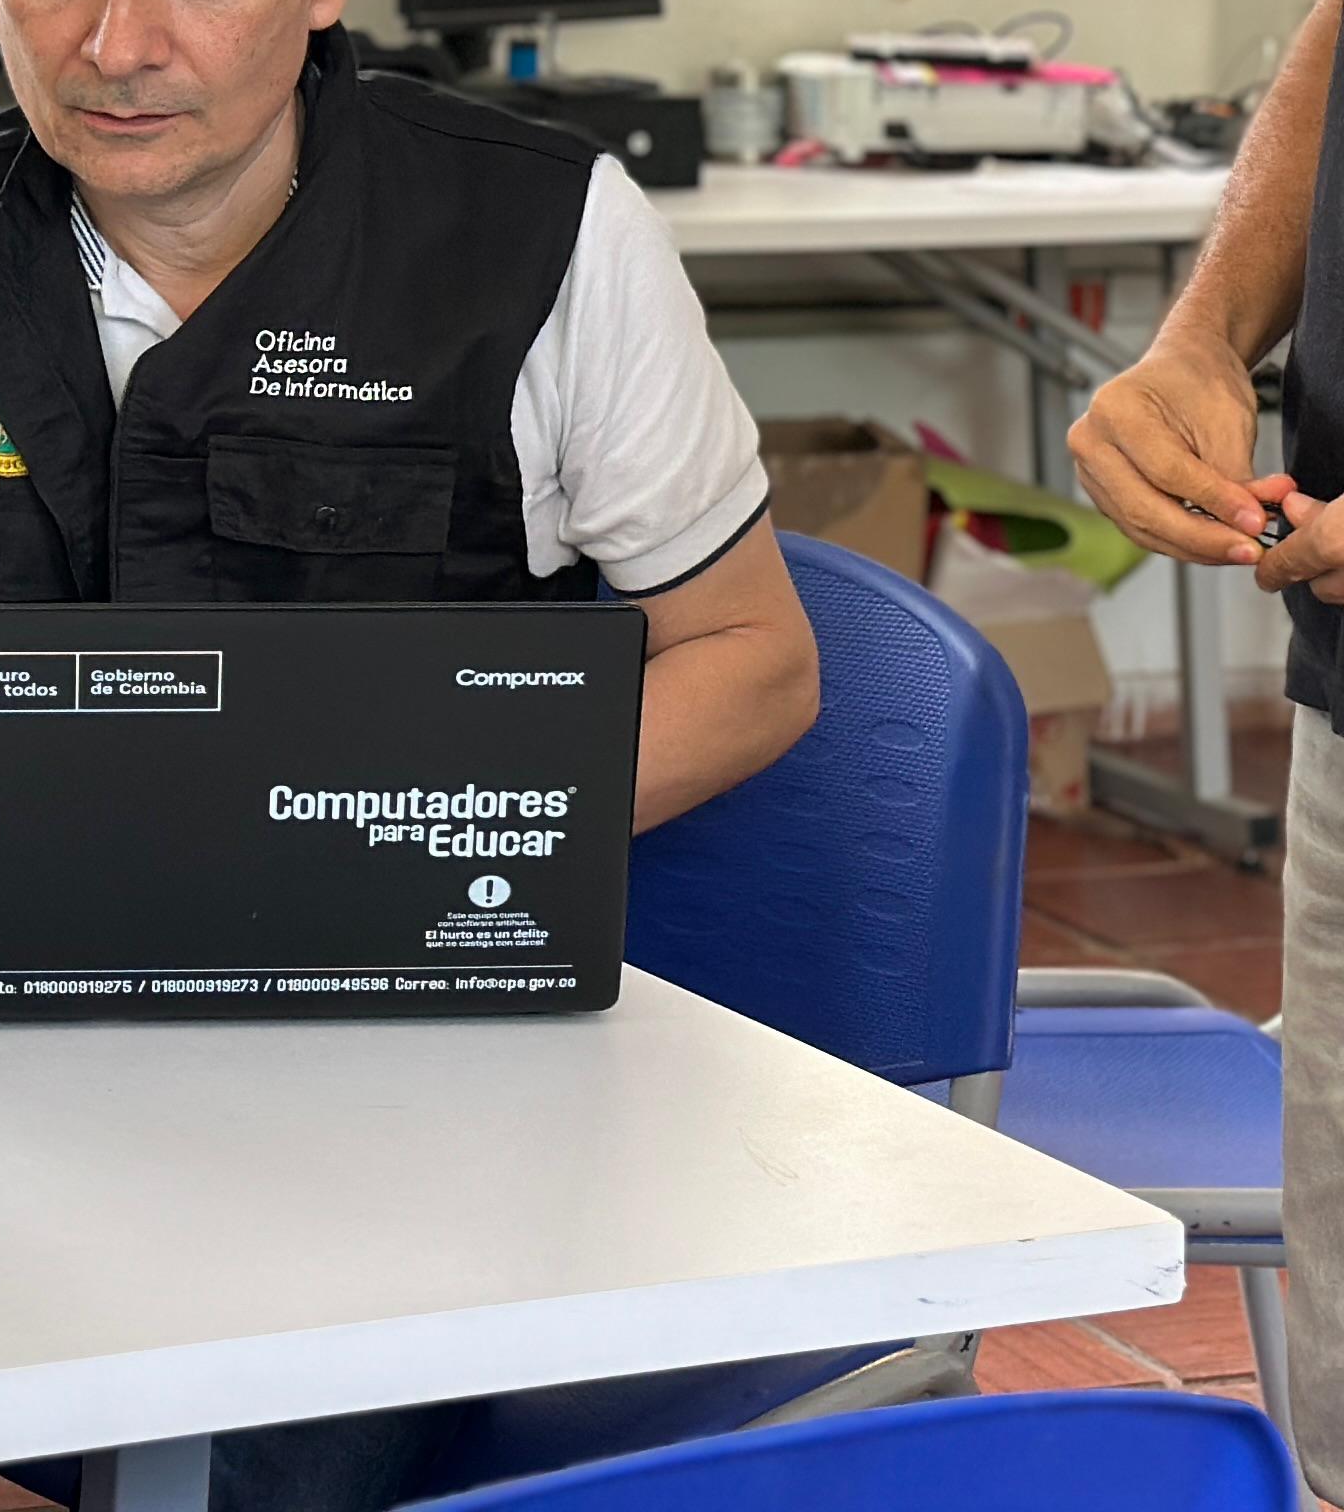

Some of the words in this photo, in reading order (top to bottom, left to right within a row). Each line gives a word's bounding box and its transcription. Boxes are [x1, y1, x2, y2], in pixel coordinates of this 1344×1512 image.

[256, 330, 335, 351] Oficina
[252, 354, 347, 373] Asesora
[250, 377, 281, 395] De
[285, 377, 412, 401] Informática
[91, 669, 174, 681] Gobierno
[456, 669, 584, 689] Compumax
[4, 683, 57, 696] todos
[91, 683, 113, 695] de
[120, 682, 206, 694] Colombia
[369, 824, 424, 846] para
[429, 824, 565, 857] Educar
[425, 930, 436, 939] El
[440, 930, 473, 939] hurto
[513, 929, 548, 938] delito
[138, 980, 146, 992] /
[264, 979, 271, 991] /
[396, 977, 449, 990] Correo:
